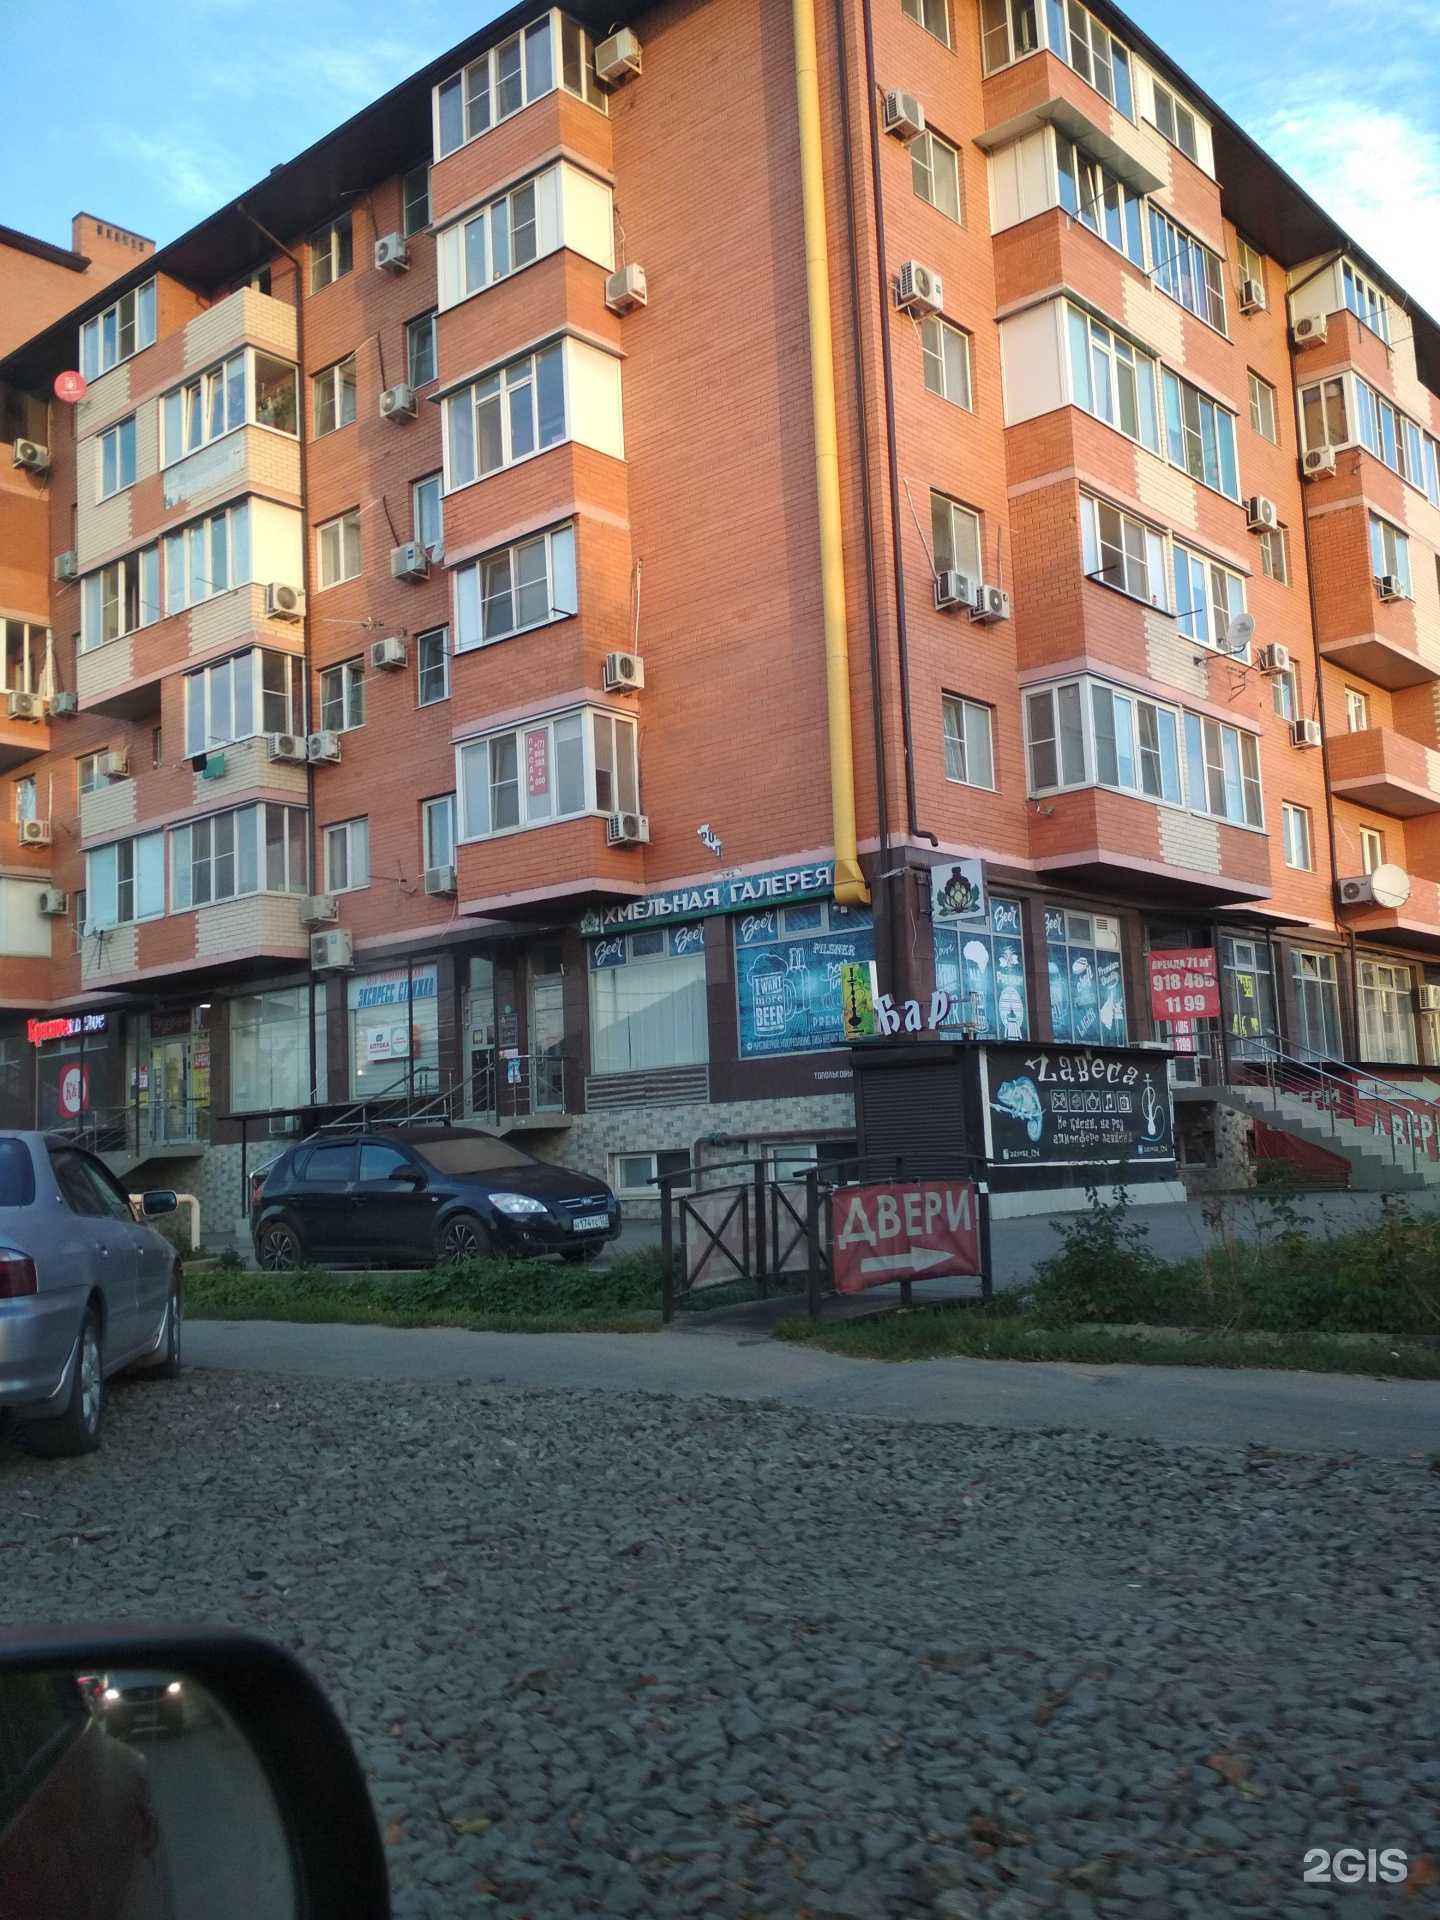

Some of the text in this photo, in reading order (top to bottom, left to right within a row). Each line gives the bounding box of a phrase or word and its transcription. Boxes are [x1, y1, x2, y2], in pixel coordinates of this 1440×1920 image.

[604, 866, 833, 925] ХМЕЛЬНАЯ ГАЛЕРЕЯ
[741, 914, 774, 944] Beer
[594, 936, 624, 966] Beer
[358, 983, 396, 1008] ЭКСПРЕСС
[1152, 973, 1181, 991] 918
[756, 1005, 784, 1026] BEER
[1166, 995, 1206, 1013] 11 99
[838, 1189, 972, 1250] ДВЕРИ
